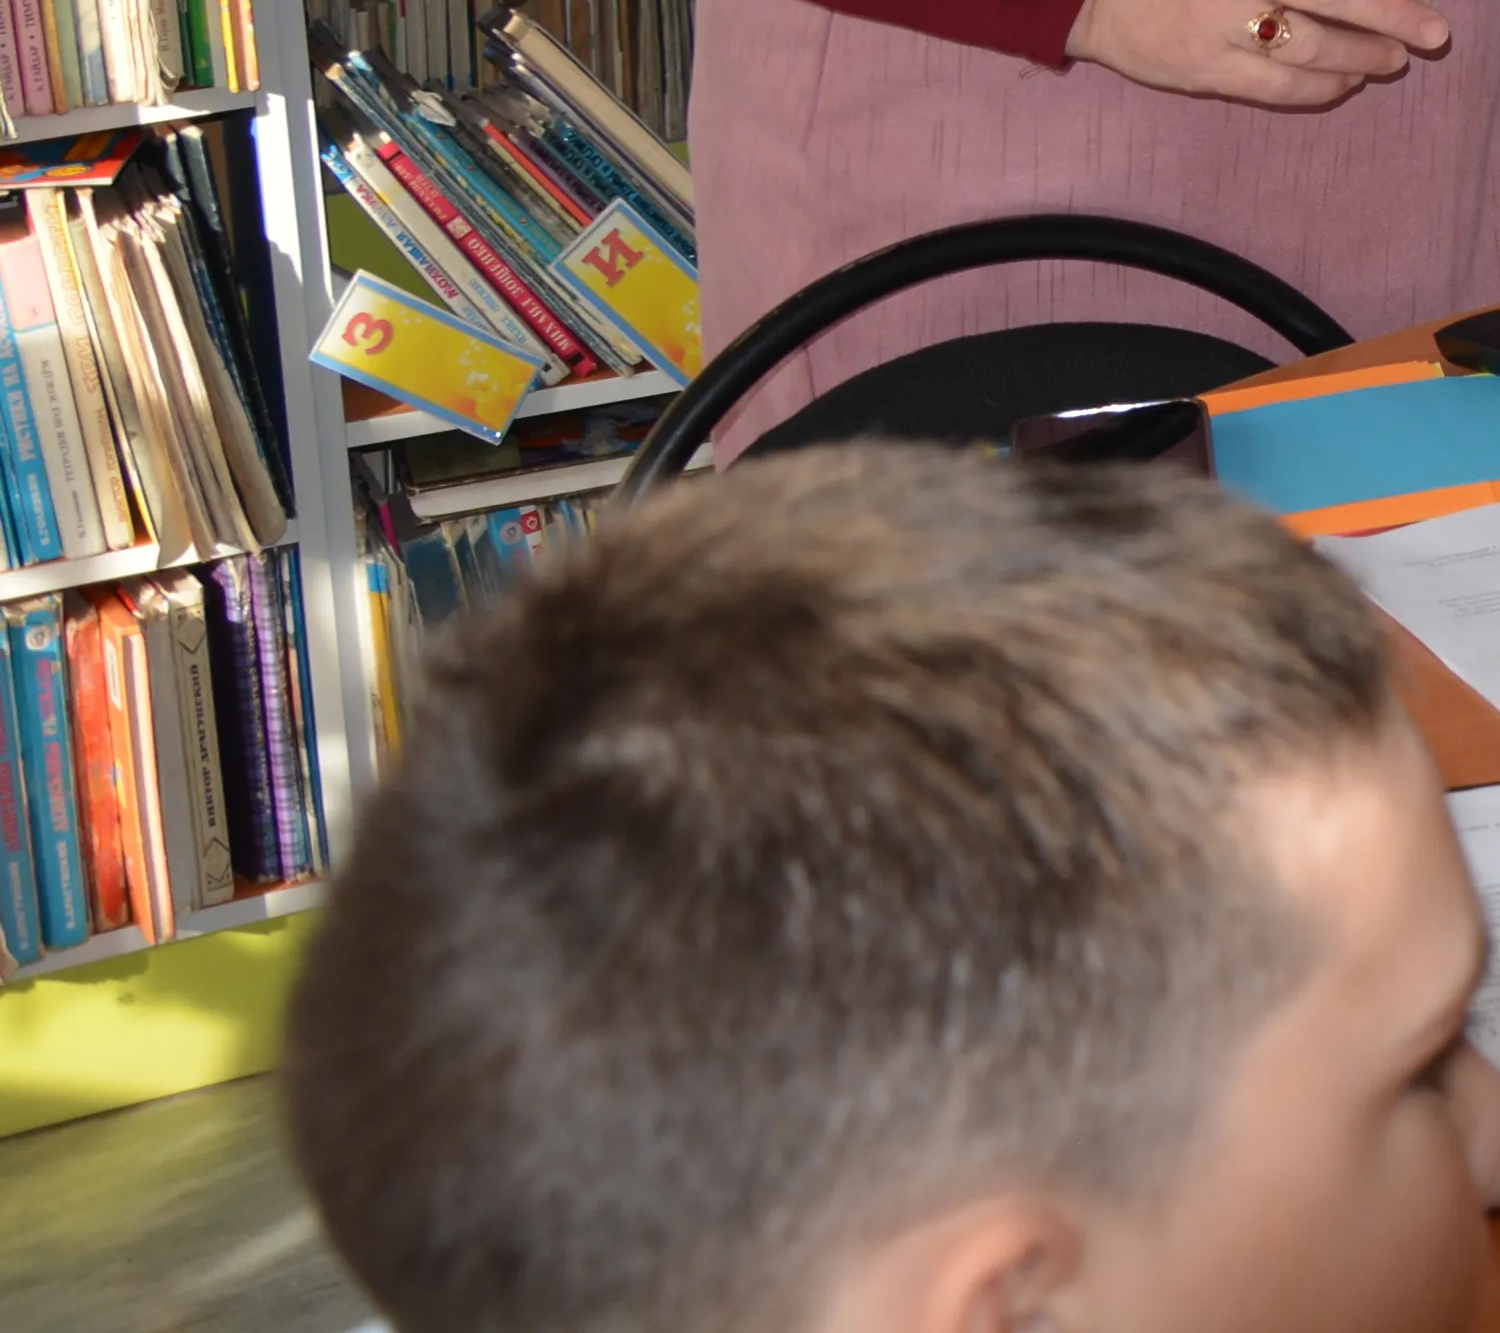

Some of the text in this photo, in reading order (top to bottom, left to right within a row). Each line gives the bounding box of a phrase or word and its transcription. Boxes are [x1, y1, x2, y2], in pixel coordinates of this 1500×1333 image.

[45, 203, 85, 326] ПОВЕСТИ
[467, 237, 522, 296] ЗОЩЕНКО
[580, 227, 645, 288] И
[341, 311, 394, 356] З
[517, 298, 574, 353] МИХАИЛ
[75, 337, 100, 395] ТРИ
[188, 663, 217, 827] ВИКТОР ДРАГУНСКИЙ
